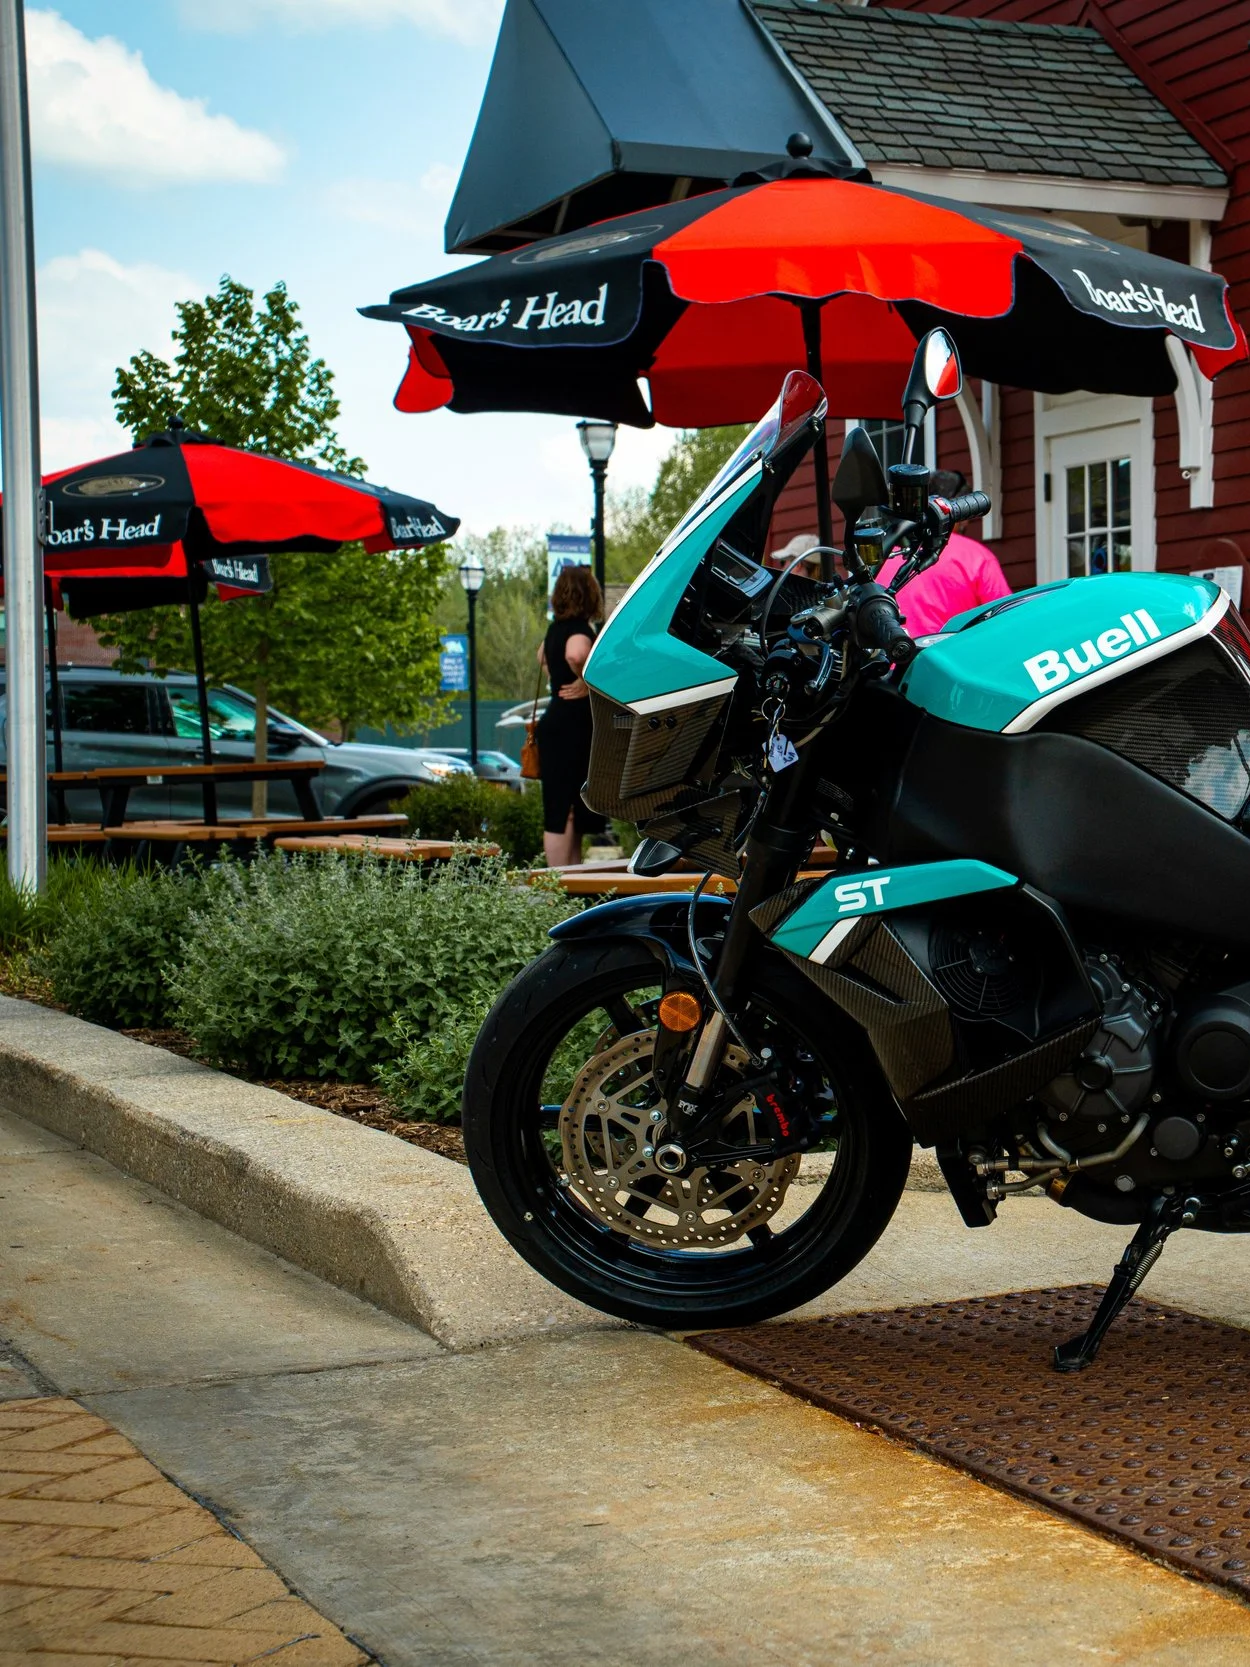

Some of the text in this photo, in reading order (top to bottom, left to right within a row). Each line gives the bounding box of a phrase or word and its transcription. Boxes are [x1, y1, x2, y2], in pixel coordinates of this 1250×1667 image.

[402, 283, 608, 331] Boar's Head
[1072, 269, 1206, 333] Boar's Head
[46, 514, 162, 546] oar's Head
[1023, 608, 1162, 694] Buell
[834, 876, 891, 912] ST
[678, 1099, 699, 1117] FOX
[766, 1094, 789, 1137] brembo
